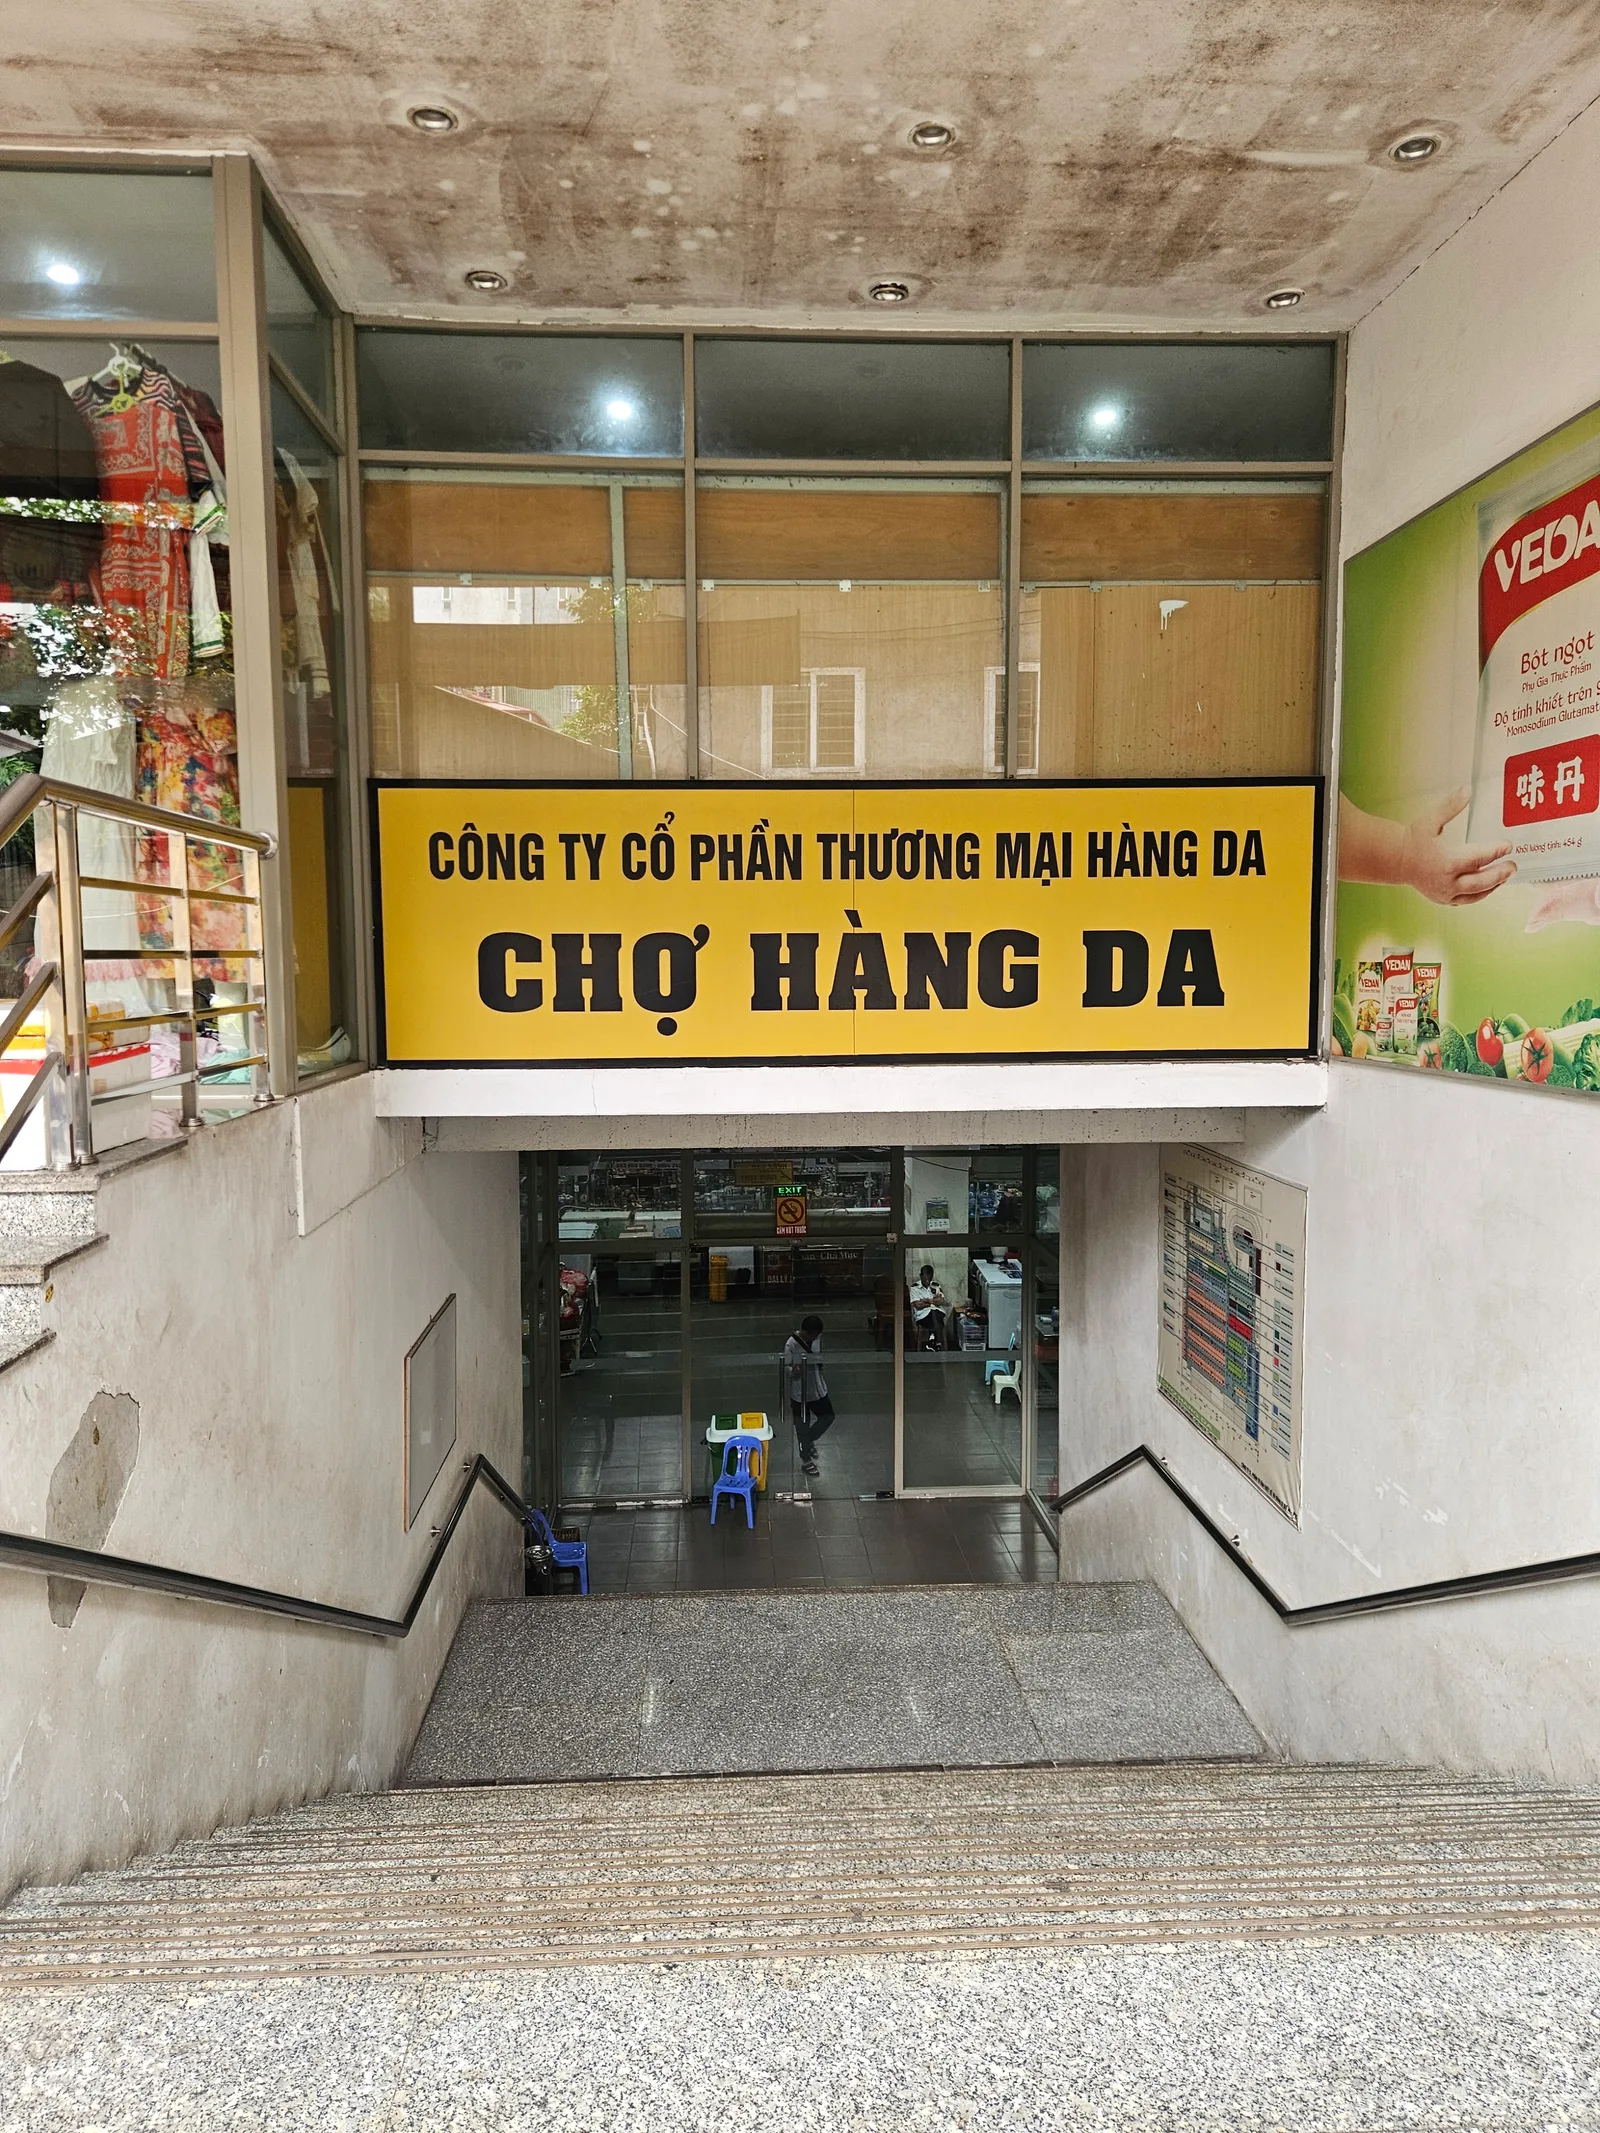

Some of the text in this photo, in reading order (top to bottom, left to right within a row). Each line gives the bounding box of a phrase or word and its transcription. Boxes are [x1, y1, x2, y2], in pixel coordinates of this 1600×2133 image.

[1521, 631, 1595, 675] Bột ngọt
[1522, 661, 1592, 693] Phụ Gia Thực Phẩm
[1494, 711, 1509, 728] Độ
[1512, 703, 1533, 721] tinh
[1535, 692, 1564, 715] khiết
[1567, 686, 1592, 704] trên
[1507, 716, 1556, 737] Monosodium
[1516, 755, 1585, 810] 味丹
[428, 811, 1267, 887] CÔNG TY CỔ PHẦN THƯƠNG MẠI HÀNG DA
[1563, 837, 1576, 846] 454
[477, 909, 1225, 1036] CHỢ HÀNG DA
[1385, 959, 1411, 971] VEDAN
[1417, 968, 1437, 978] VEDAN
[1361, 979, 1379, 988] VEDAN
[1399, 1000, 1415, 1008] VEDAN
[778, 1186, 802, 1194] EXIT
